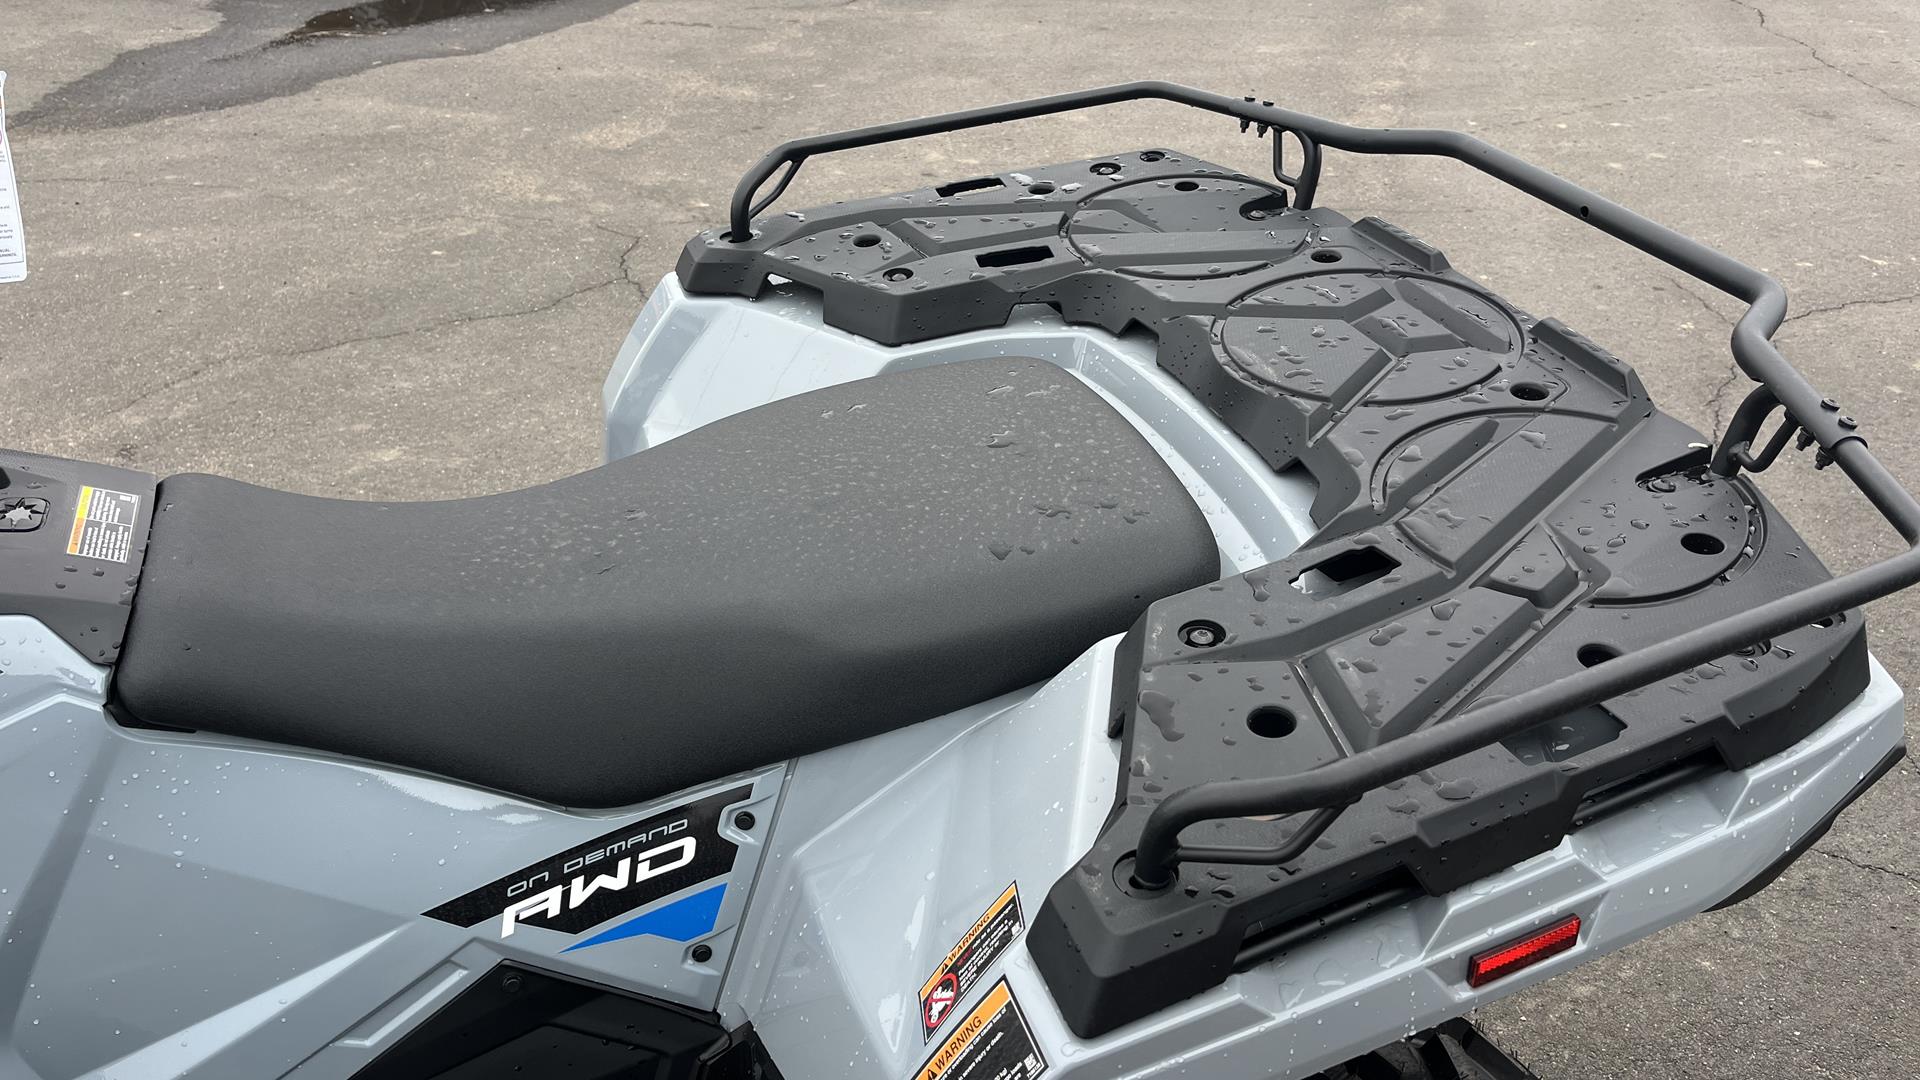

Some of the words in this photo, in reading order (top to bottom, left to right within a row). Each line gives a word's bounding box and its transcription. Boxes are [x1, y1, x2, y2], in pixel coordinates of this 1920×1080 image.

[506, 871, 549, 898] ON
[563, 818, 688, 875] DEMAND
[500, 836, 698, 940] AWD
[949, 913, 989, 962] WARNING
[935, 1016, 982, 1070] WARNING
[952, 1044, 974, 1069] overloading
[973, 1035, 981, 1045] can
[980, 1022, 993, 1036] cause
[992, 1013, 1001, 1023] loss
[1001, 1005, 1006, 1014] of
[962, 1062, 975, 1077] severe
[975, 1049, 986, 1063] injury
[990, 1032, 1004, 1046] death.
